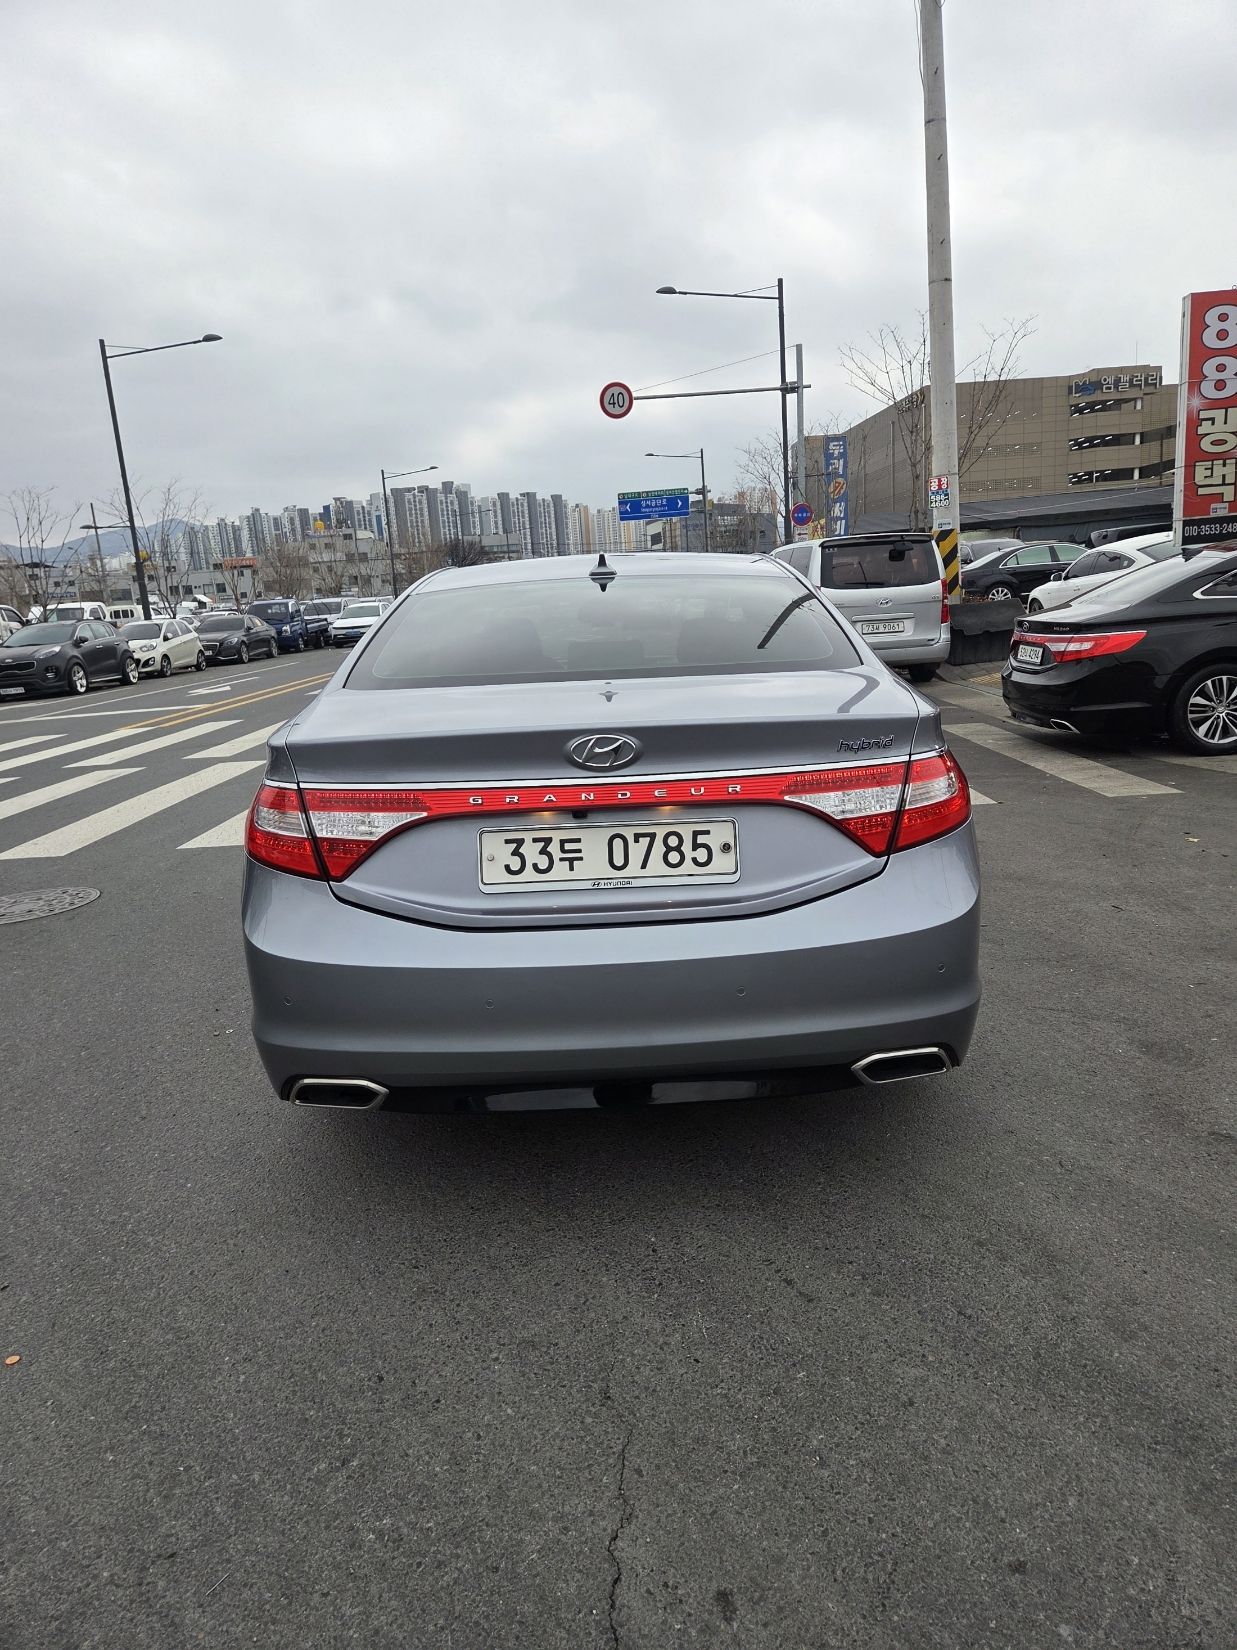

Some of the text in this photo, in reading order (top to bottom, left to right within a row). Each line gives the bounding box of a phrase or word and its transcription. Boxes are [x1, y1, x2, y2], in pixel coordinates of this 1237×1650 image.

[1101, 372, 1160, 393] 엠갤러리
[608, 391, 625, 409] 40
[882, 623, 900, 632] 9061
[837, 735, 895, 754] hybrid
[469, 784, 742, 805] GRANDEUR
[503, 829, 714, 876] 33두 0785
